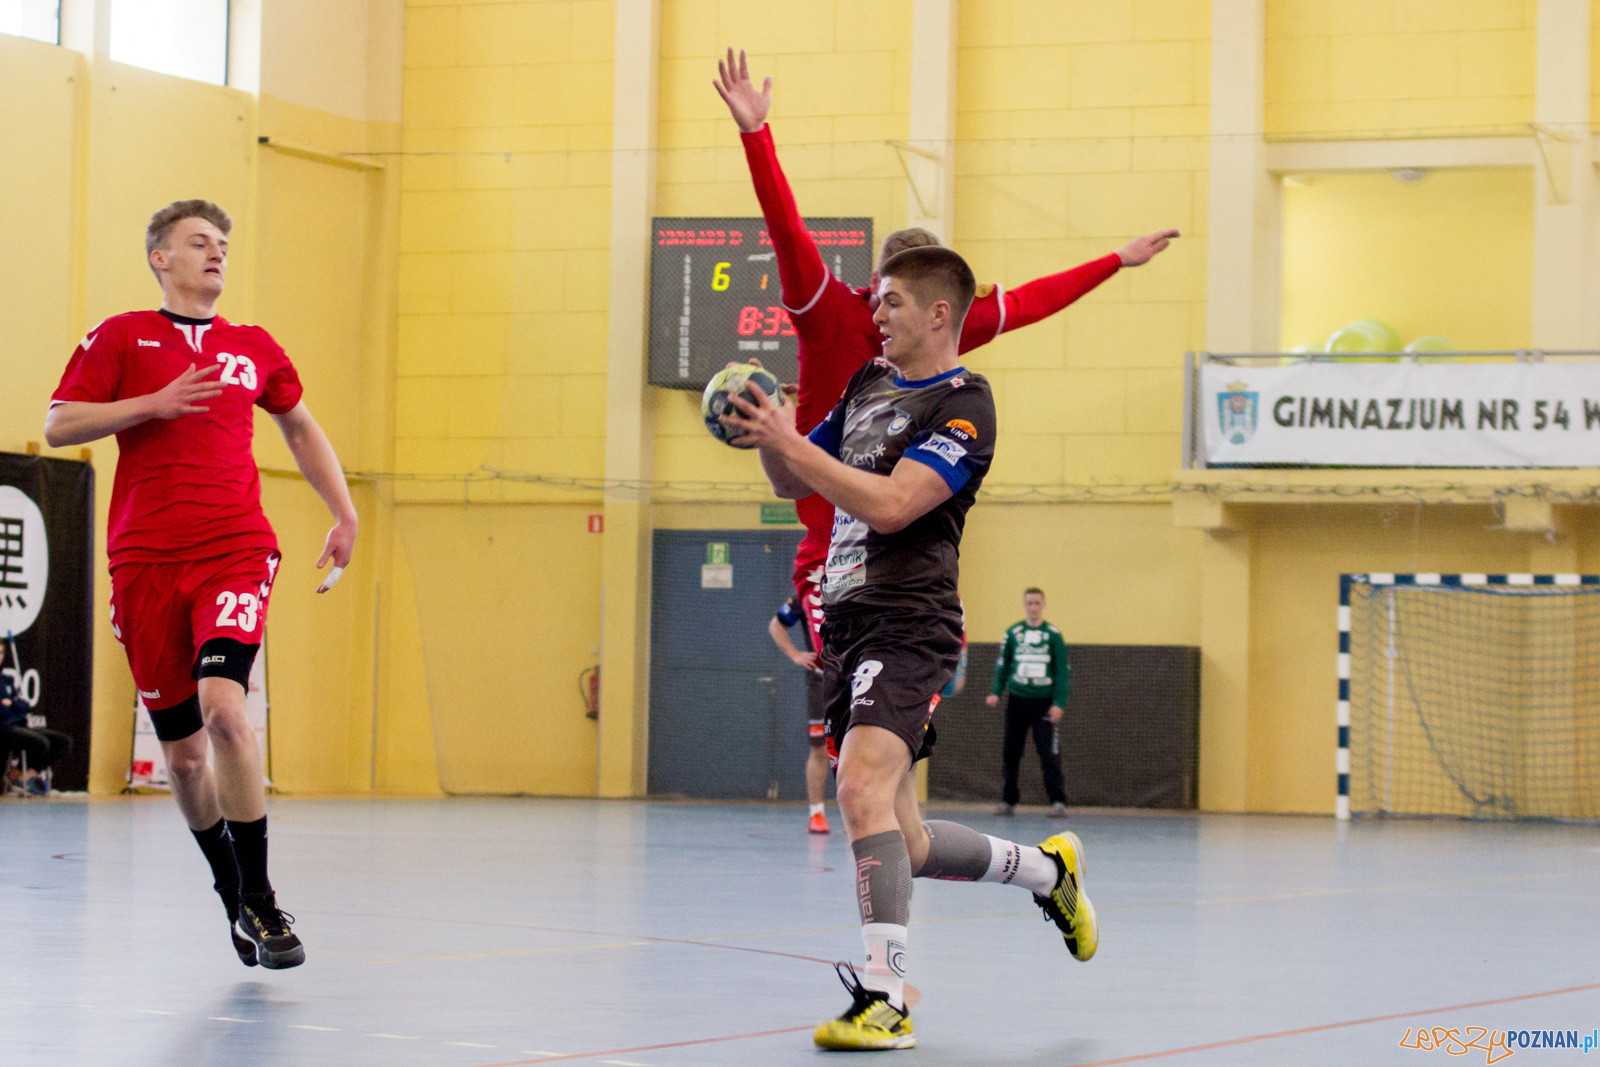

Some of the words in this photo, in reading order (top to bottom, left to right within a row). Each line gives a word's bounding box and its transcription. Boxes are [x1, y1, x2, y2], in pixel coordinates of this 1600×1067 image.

[216, 352, 258, 391] 23
[1273, 395, 1466, 431] GIMNAZJUM
[1477, 398, 1521, 431] NR
[1532, 400, 1571, 431] 54
[950, 427, 969, 441] UNO
[215, 590, 258, 633] 23
